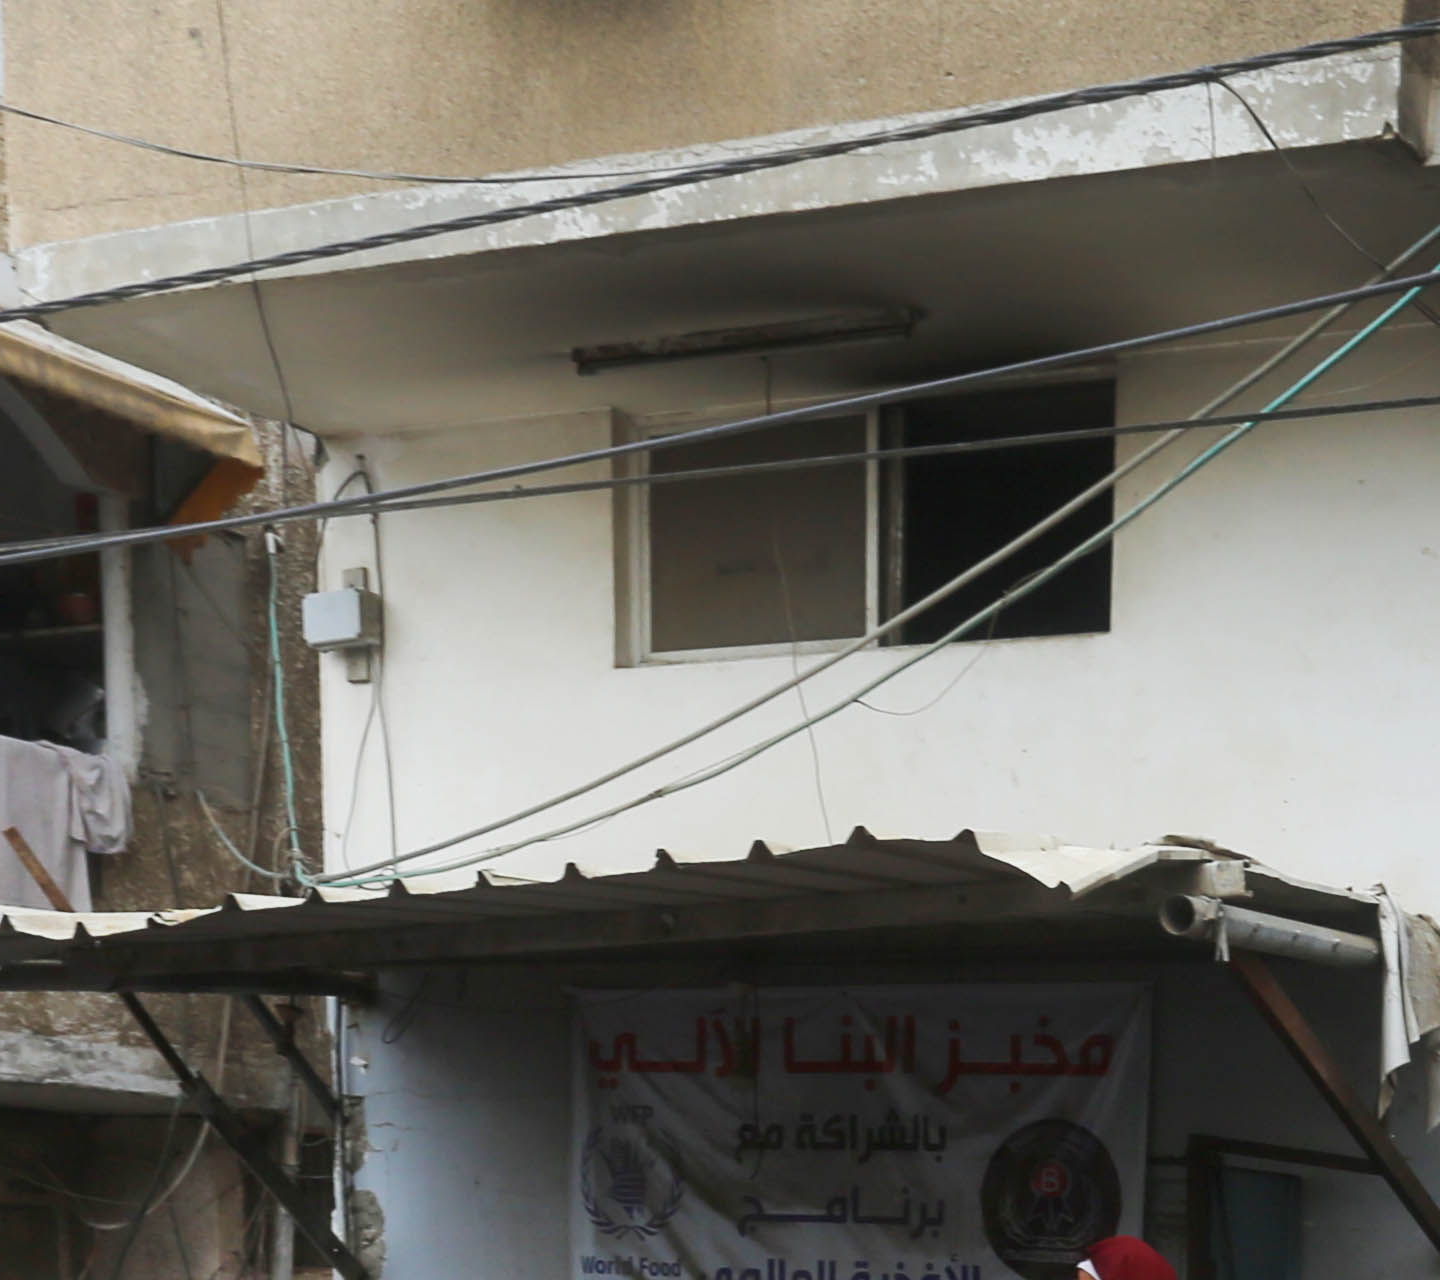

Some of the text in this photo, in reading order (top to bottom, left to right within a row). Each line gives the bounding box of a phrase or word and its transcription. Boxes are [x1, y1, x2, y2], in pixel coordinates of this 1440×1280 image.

[783, 1014, 917, 1090] البنا
[942, 1014, 1116, 1093] مخبز
[734, 1114, 785, 1163] مع
[799, 1106, 948, 1164] بالشراكة
[739, 1184, 945, 1238] برنامج
[640, 1257, 682, 1277] Food
